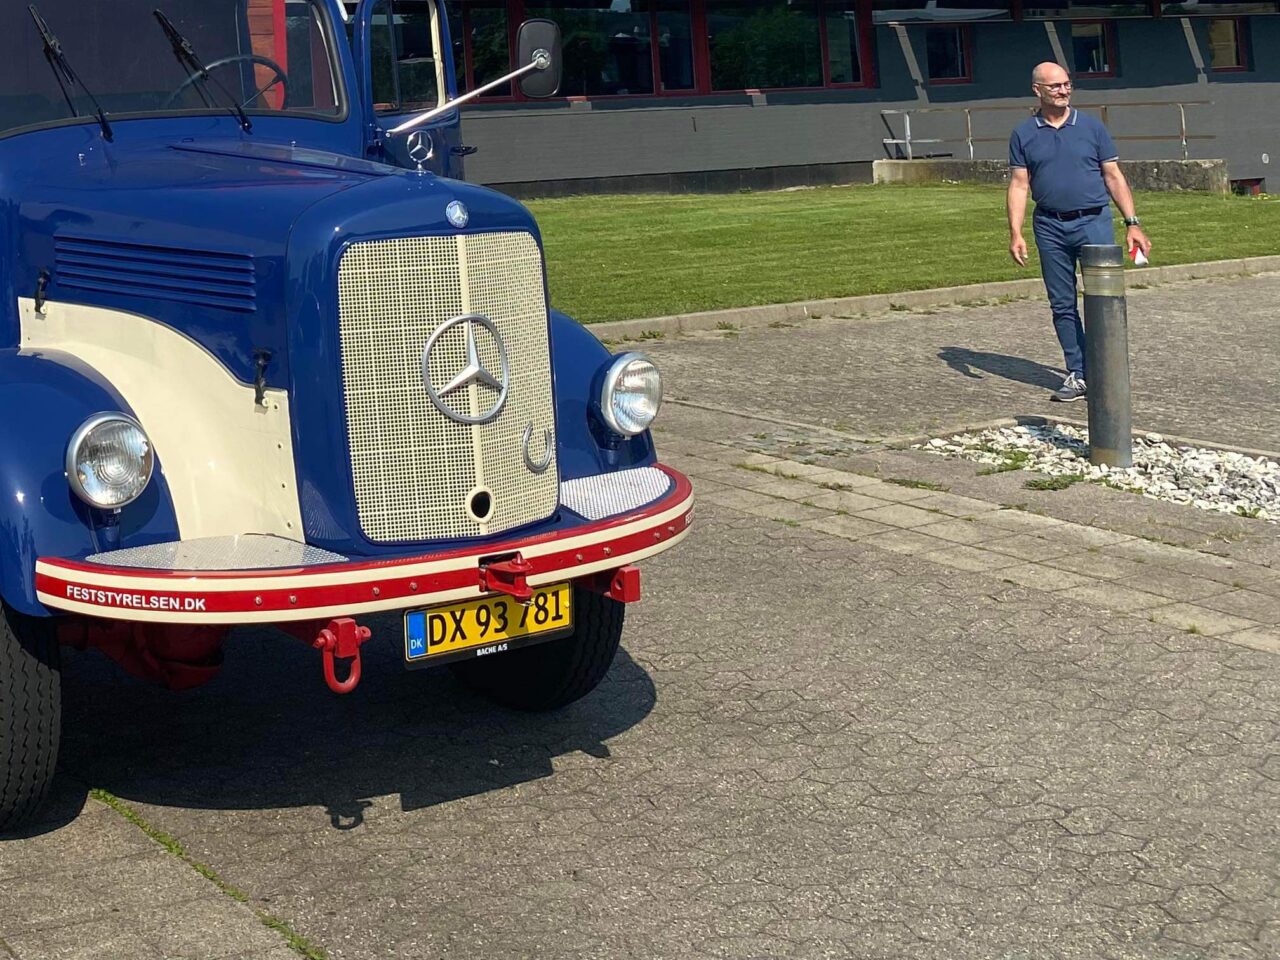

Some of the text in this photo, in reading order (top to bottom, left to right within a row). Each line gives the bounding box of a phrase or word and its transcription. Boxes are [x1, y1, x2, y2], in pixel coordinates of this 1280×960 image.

[66, 584, 207, 611] FESTSTYRELSEN.DK
[428, 608, 468, 647] DX
[475, 600, 509, 638] 93
[410, 638, 423, 650] DK
[476, 645, 497, 656] BACHE
